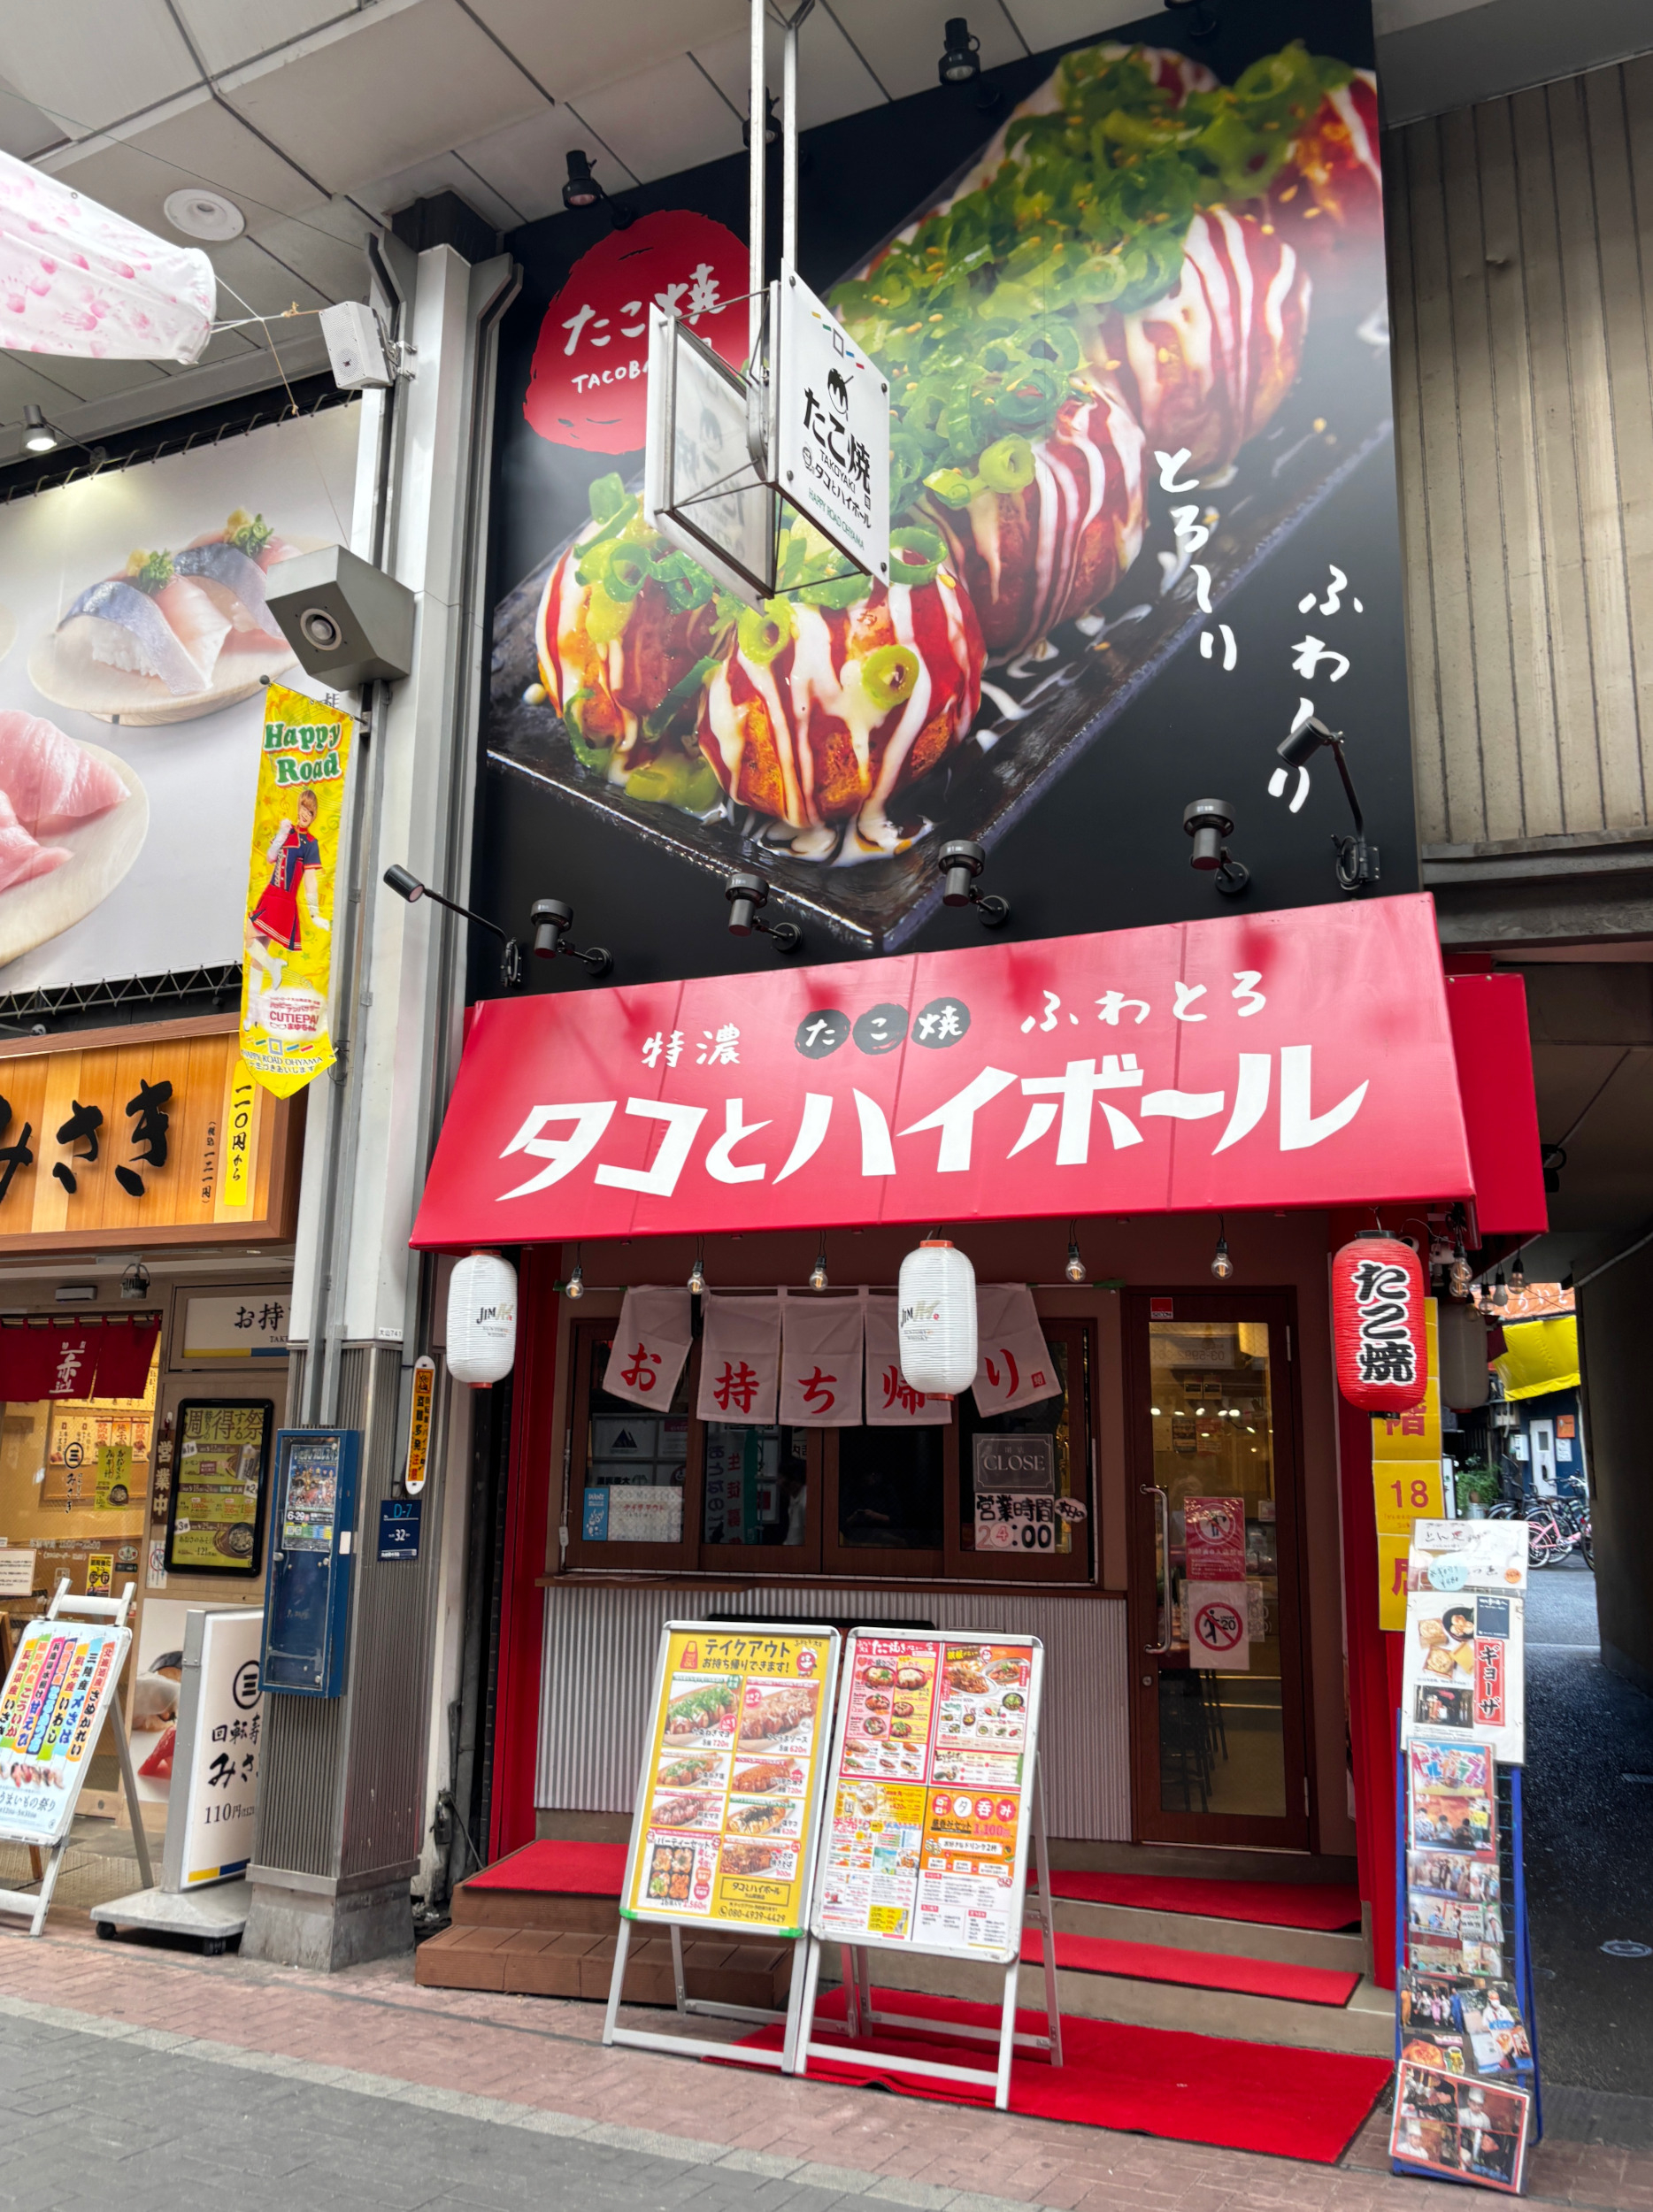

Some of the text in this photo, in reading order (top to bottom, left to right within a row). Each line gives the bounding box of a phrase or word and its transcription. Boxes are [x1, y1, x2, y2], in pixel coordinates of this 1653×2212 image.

[803, 387, 871, 495] たこ焼
[819, 449, 856, 494] TAKOYAKI
[815, 463, 872, 528] タコとハイボール
[265, 723, 342, 752] Happy
[277, 751, 342, 782] Road
[641, 970, 1267, 1068] 特濃 たこ焼 ふわとろ
[495, 1044, 1370, 1202] タコとハイボール
[234, 1302, 291, 1331] お持
[1354, 1263, 1415, 1383] たこ焼
[983, 1455, 1045, 1471] CLOSE
[152, 1440, 173, 1517] 営業中
[977, 1494, 1053, 1523] 営業時間
[1390, 1479, 1429, 1509] 18
[394, 1503, 412, 1518] D-7
[394, 1528, 406, 1541] 32
[1219, 1619, 1236, 1631] 20
[704, 1640, 790, 1658] テイクアウト
[703, 1658, 789, 1673] お持ち帰りできます!
[1479, 1644, 1501, 1719] ギョーザ
[208, 1753, 258, 1789] みさ
[732, 1882, 781, 1895] タコとハイボール
